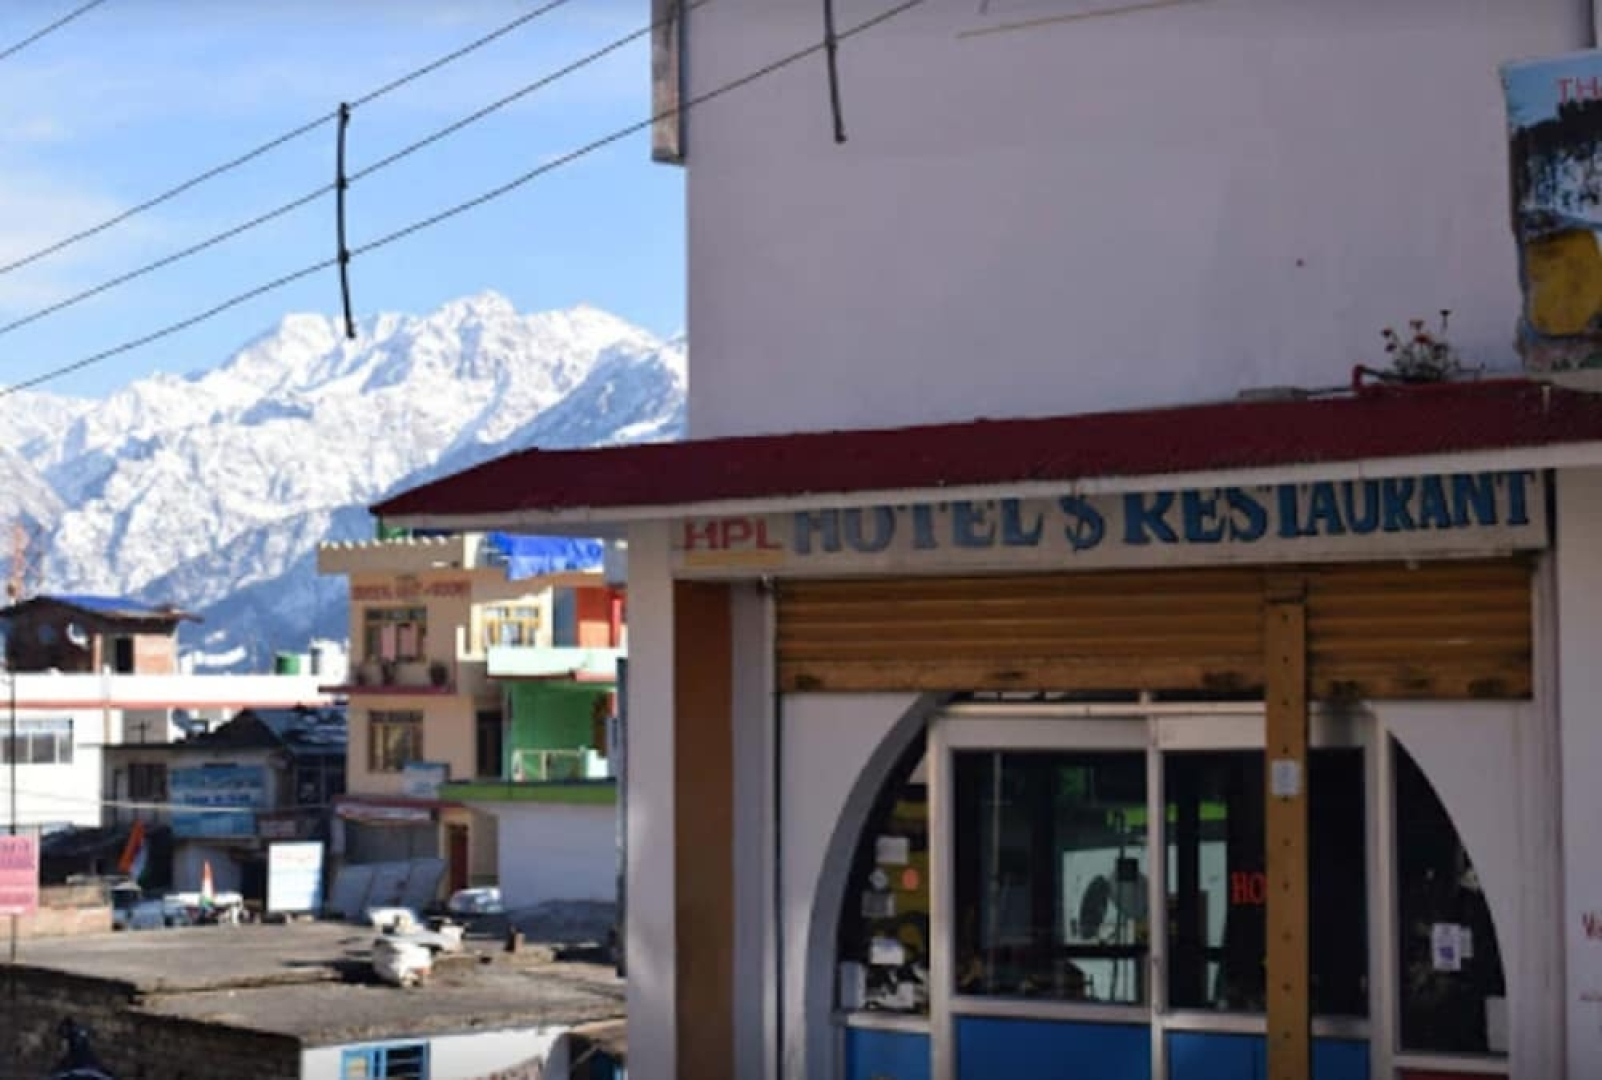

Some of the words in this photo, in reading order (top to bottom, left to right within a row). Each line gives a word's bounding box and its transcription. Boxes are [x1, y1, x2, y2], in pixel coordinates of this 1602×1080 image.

[684, 514, 782, 551] HPL
[794, 497, 1045, 556] HOTEL
[1123, 472, 1535, 545] RESTAURANT
